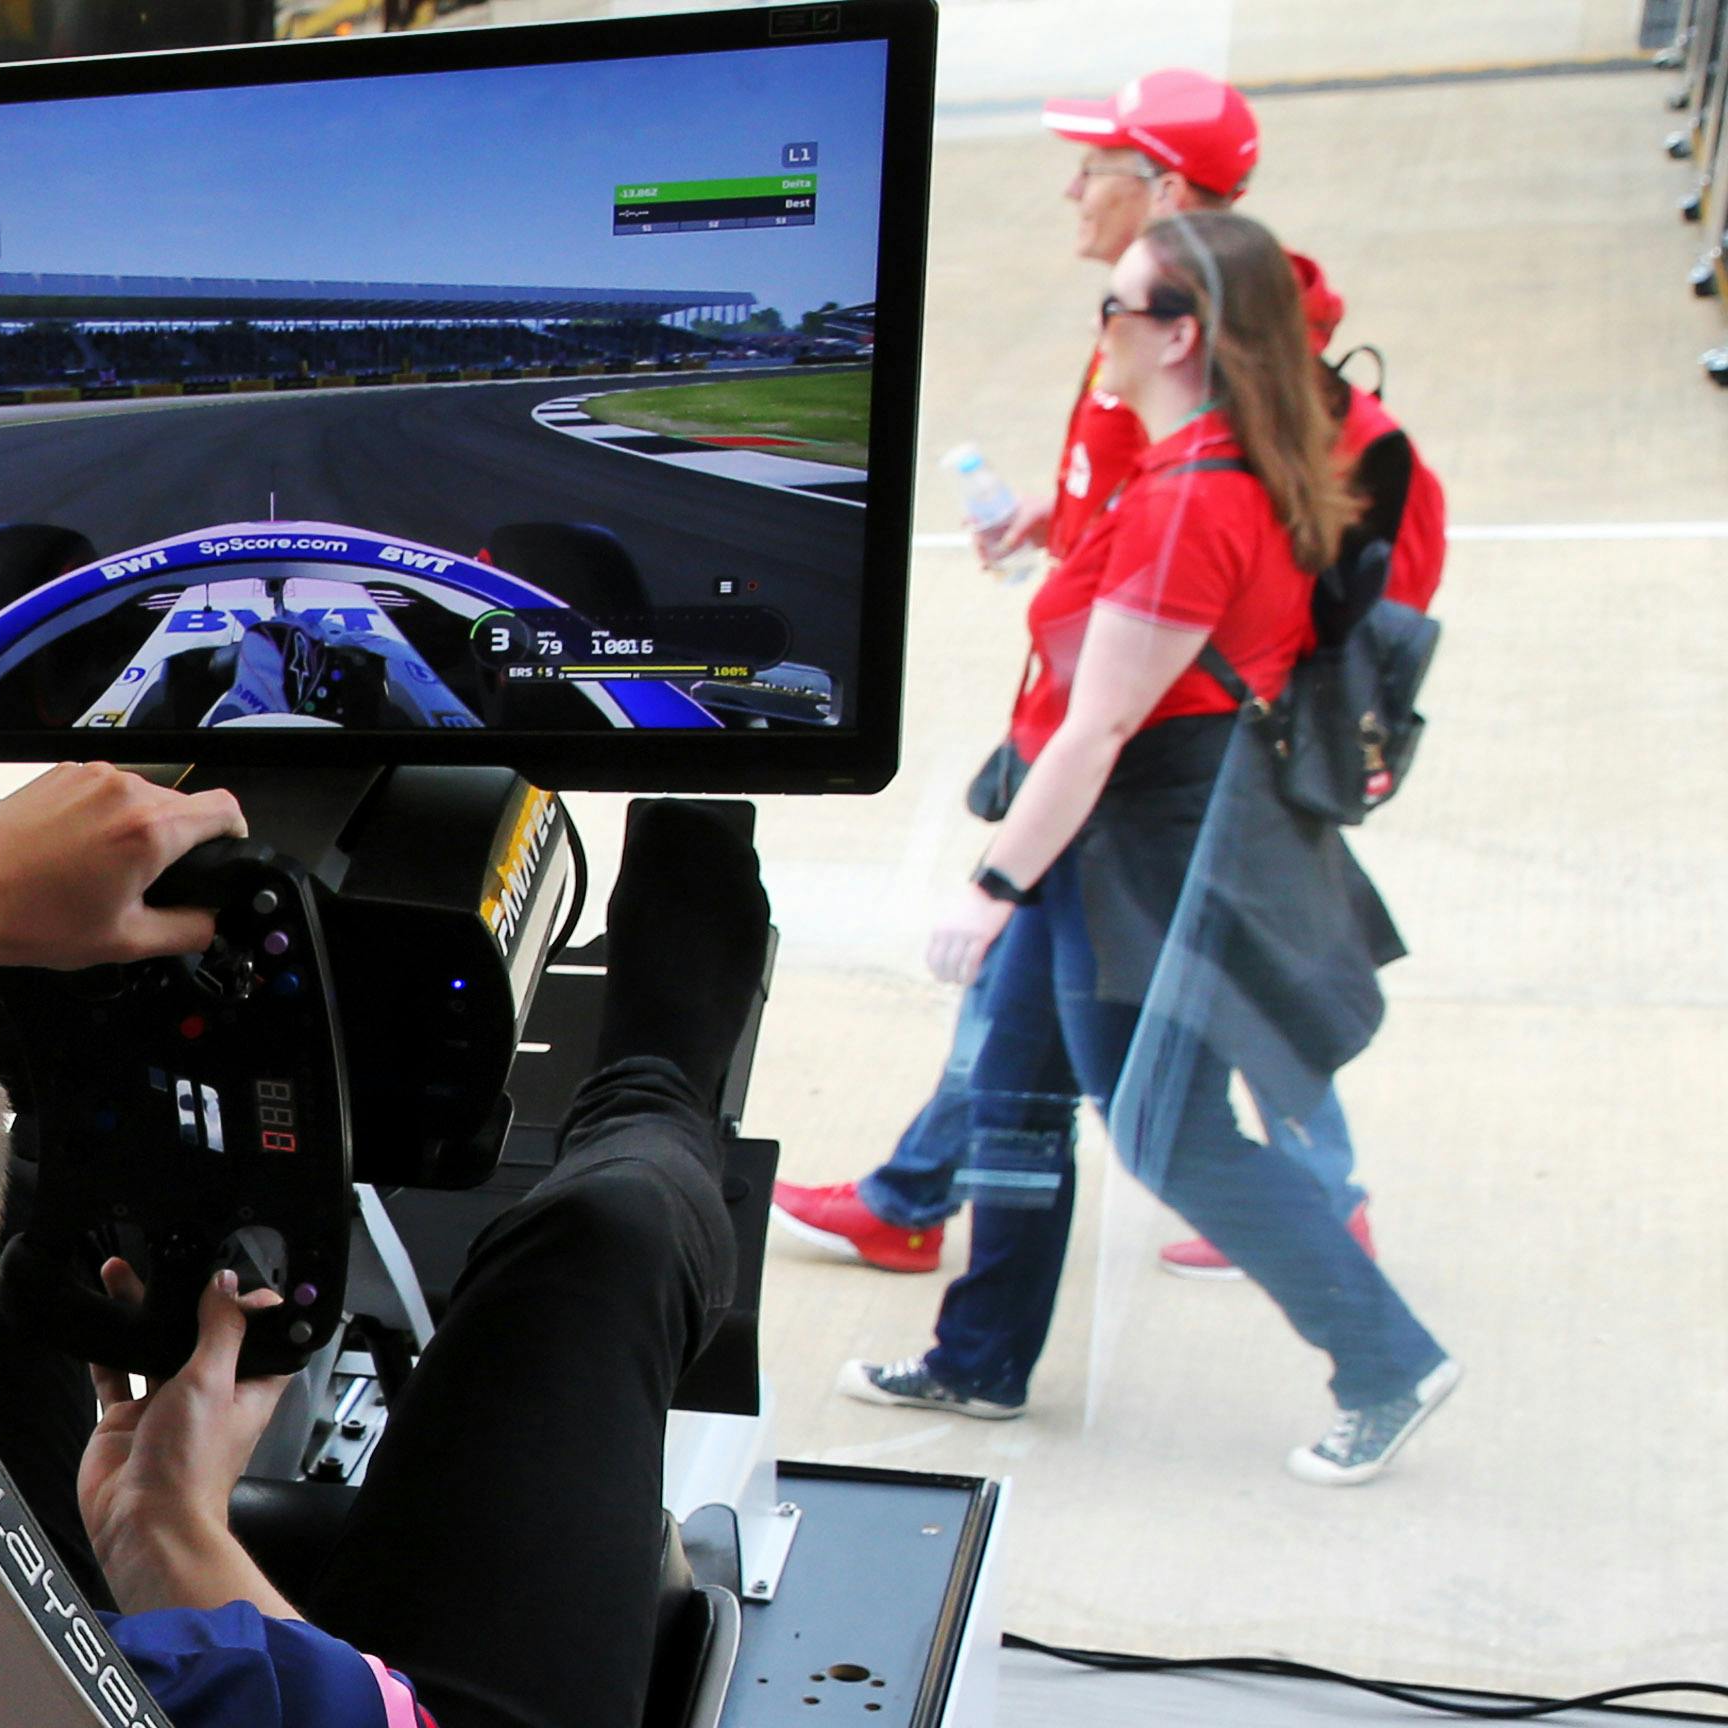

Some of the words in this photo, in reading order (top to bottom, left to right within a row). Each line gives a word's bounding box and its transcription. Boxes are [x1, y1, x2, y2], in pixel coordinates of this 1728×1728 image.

[788, 147, 811, 162] L1
[782, 179, 811, 190] Delta
[785, 199, 811, 209] Best
[100, 549, 169, 581] BWT
[199, 537, 348, 557] SpScore.com
[378, 545, 457, 575] BWT
[491, 628, 510, 652] 3
[537, 639, 563, 655] 79
[509, 667, 533, 678] ERS
[544, 667, 553, 677] 5
[713, 666, 748, 678] 100%
[491, 790, 556, 957] FANATEC
